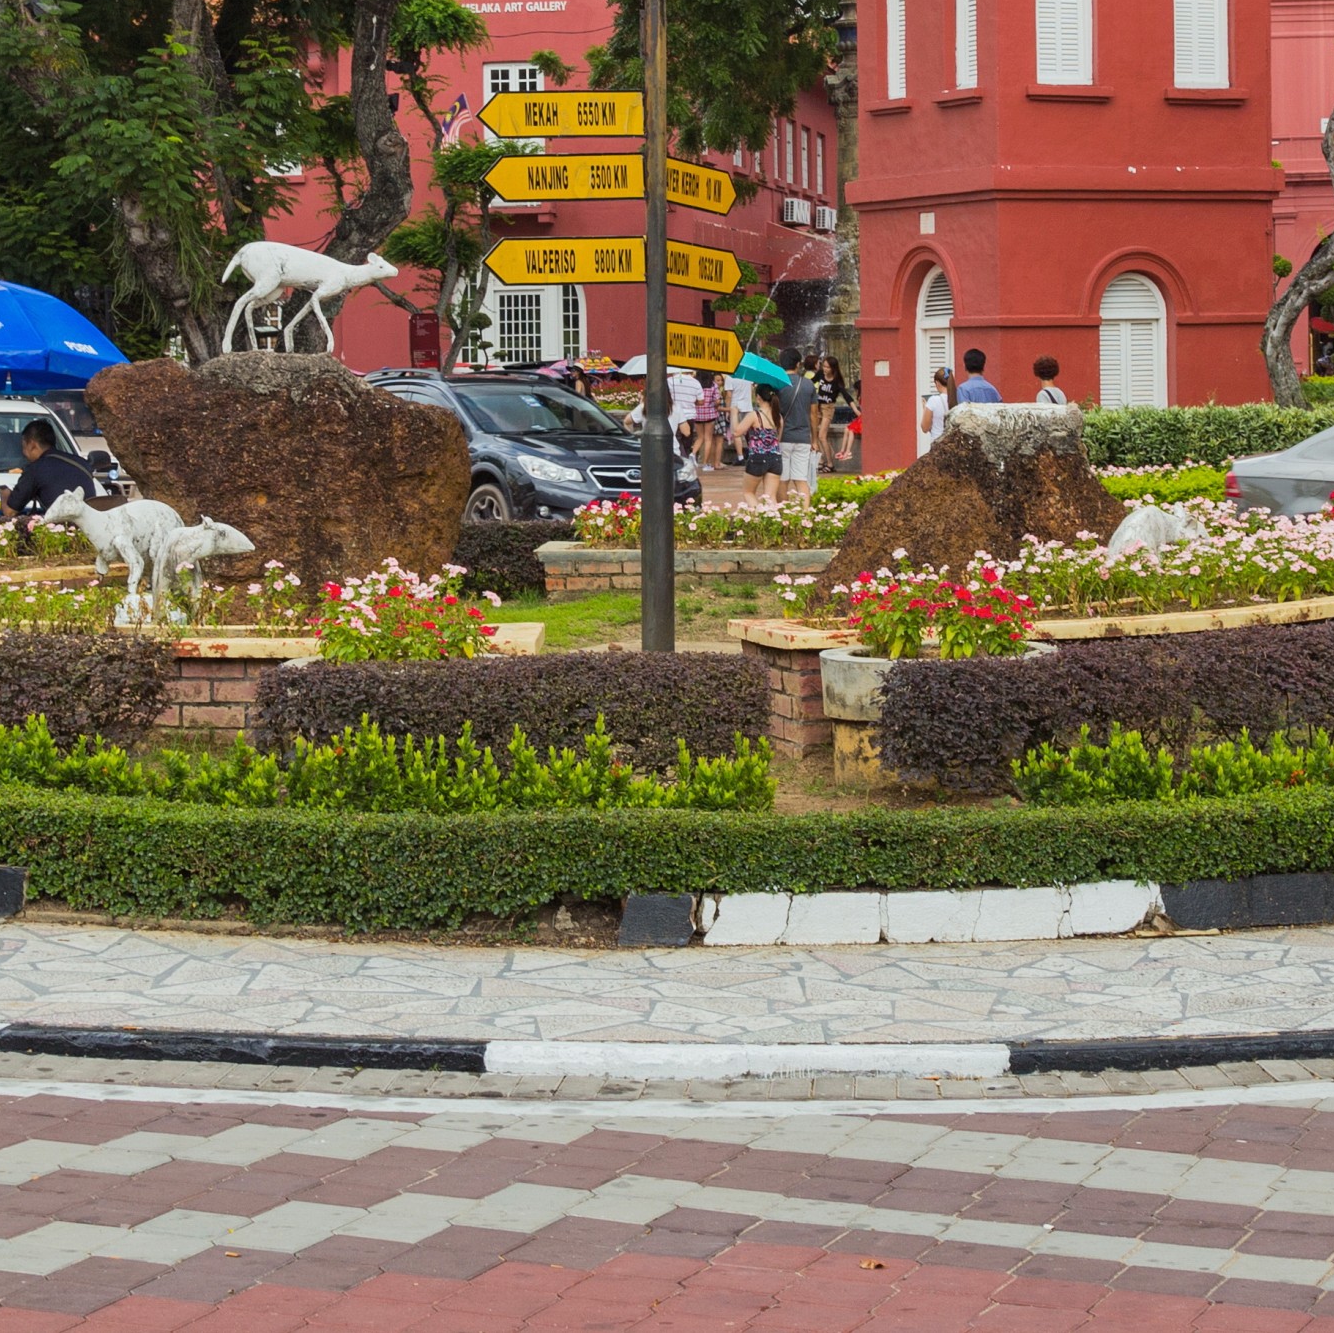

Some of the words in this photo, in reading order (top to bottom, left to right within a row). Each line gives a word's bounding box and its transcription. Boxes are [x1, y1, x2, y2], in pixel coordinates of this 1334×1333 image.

[504, 2, 523, 13] ART
[526, 0, 567, 12] GALLERY
[525, 102, 558, 126] MEKAH
[577, 102, 599, 126] 6550
[602, 102, 616, 126] KM
[528, 166, 568, 190] NANJING
[590, 165, 611, 189] 5500
[614, 165, 628, 189] KM
[682, 171, 699, 198] KEROH
[714, 179, 722, 203] KM
[525, 249, 576, 274] VALPERISO
[594, 248, 616, 273] 9800
[618, 248, 632, 273] KM
[714, 259, 723, 283] KM
[721, 339, 729, 364] KM
